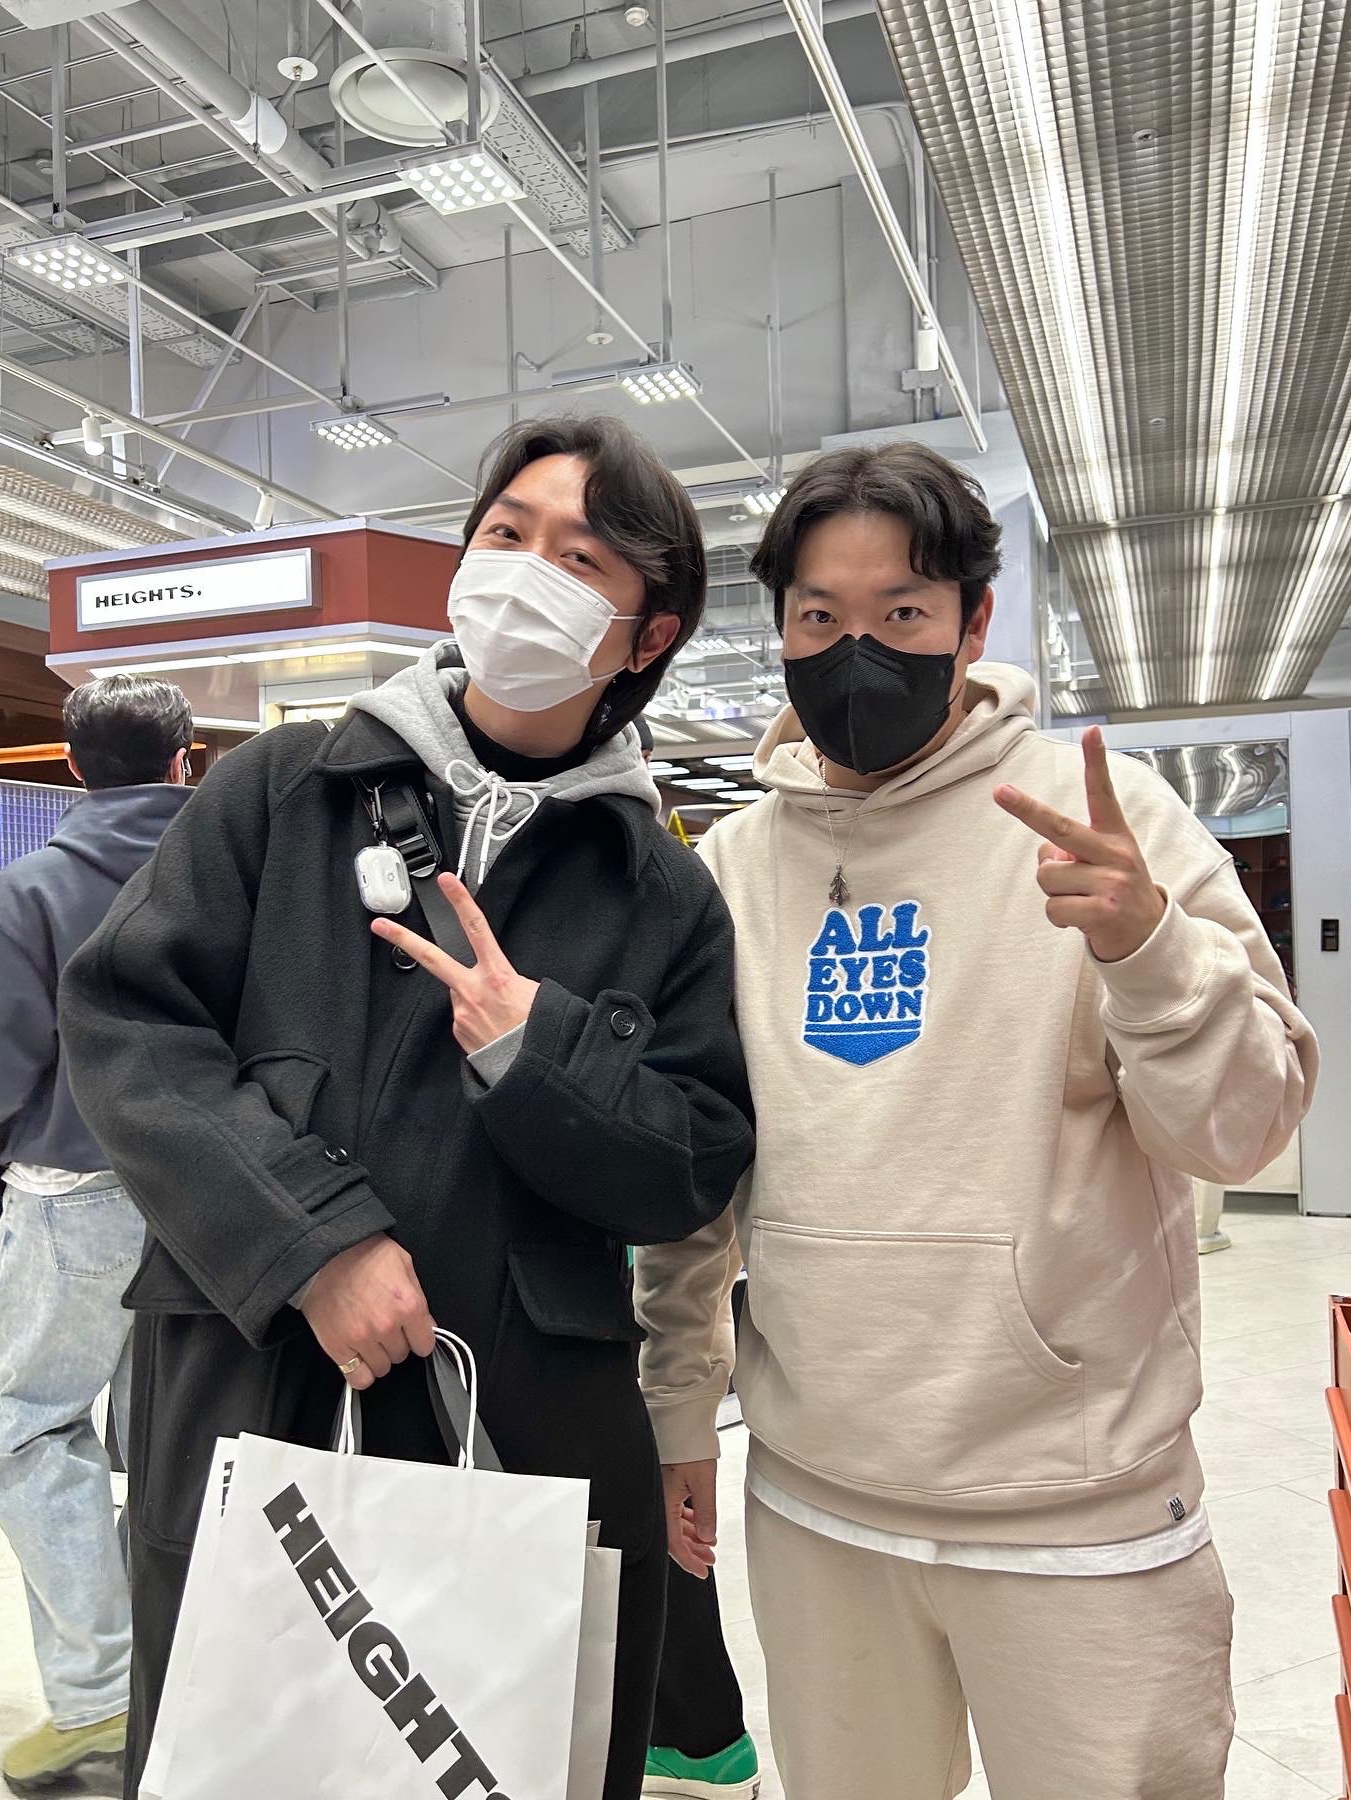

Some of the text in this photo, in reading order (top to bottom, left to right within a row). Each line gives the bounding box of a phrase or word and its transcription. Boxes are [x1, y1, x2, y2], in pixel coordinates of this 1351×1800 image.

[810, 902, 929, 957] ALL
[807, 949, 927, 993] EYES
[805, 989, 924, 1023] DOWN
[263, 1481, 512, 1800] HEIGHT
